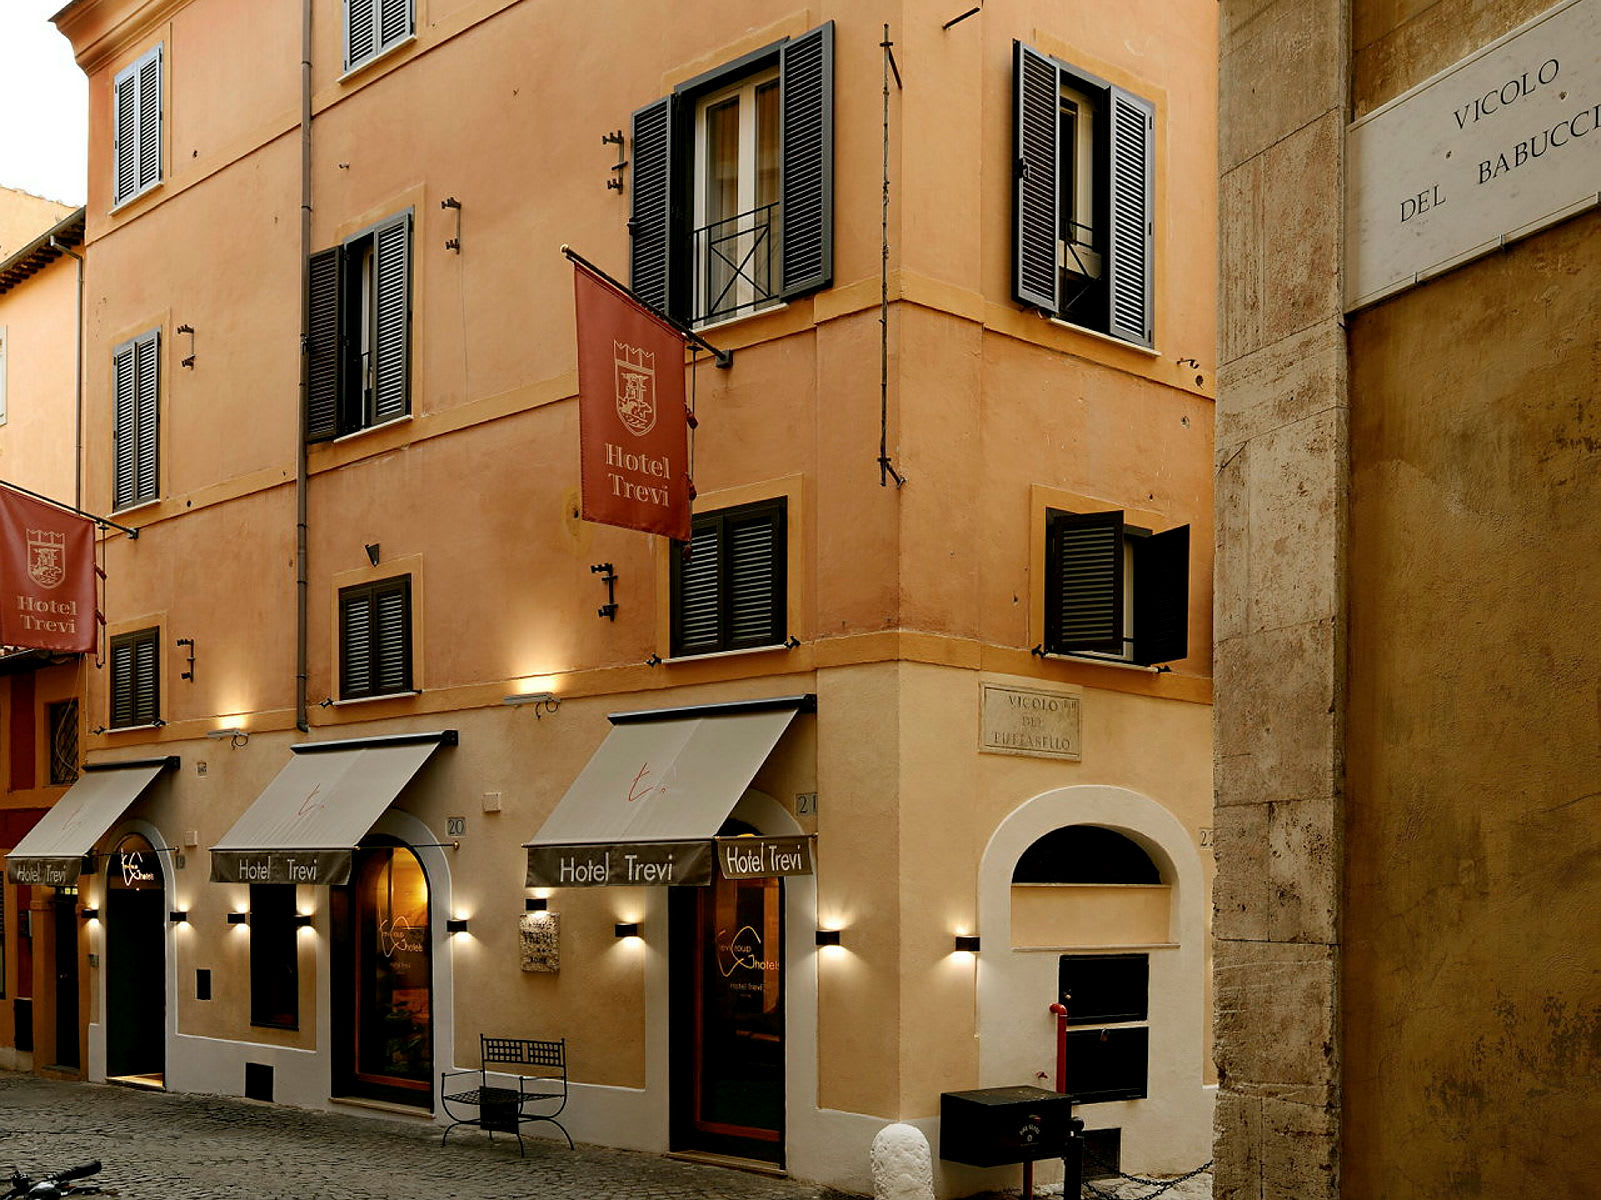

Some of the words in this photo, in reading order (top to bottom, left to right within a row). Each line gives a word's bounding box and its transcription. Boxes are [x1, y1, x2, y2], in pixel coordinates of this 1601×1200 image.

[1453, 58, 1560, 130] VICOLO
[1400, 183, 1447, 223] DEL
[605, 442, 671, 480] Hotel
[608, 473, 670, 508] Trevi
[17, 595, 78, 616] Hotel
[20, 614, 76, 634] Trevi
[1009, 695, 1059, 711] VICOLO
[797, 795, 817, 814] 21
[448, 819, 465, 835] 20
[239, 856, 271, 880] Hotel
[286, 859, 317, 881] Trevi
[559, 852, 610, 883] Hotel
[624, 854, 674, 881] Trevi
[727, 842, 765, 873] Hotel
[768, 844, 802, 871] Trevi
[16, 862, 41, 882] Hotel
[46, 864, 66, 883] Trevi
